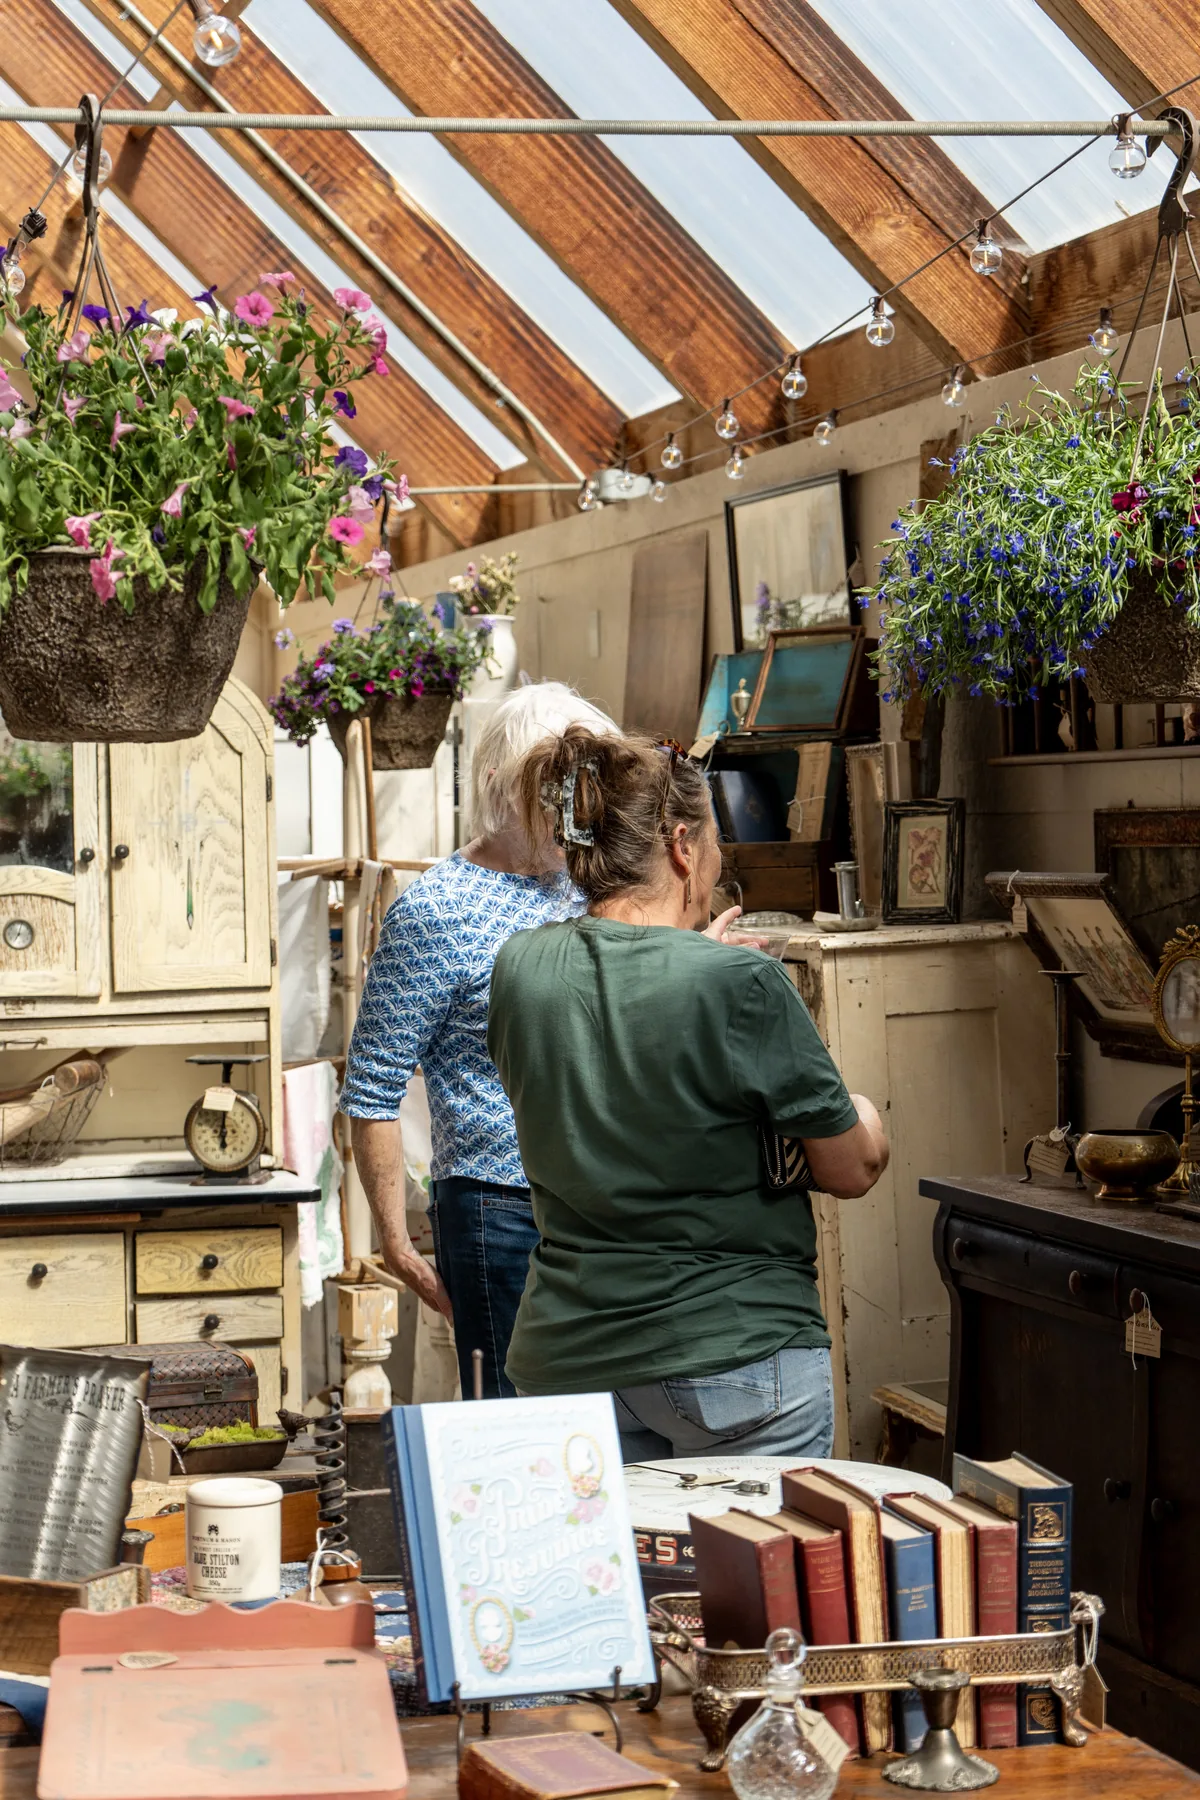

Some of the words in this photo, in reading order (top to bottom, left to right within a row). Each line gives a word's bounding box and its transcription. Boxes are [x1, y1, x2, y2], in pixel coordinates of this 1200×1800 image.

[10, 1374, 20, 1398] A
[23, 1375, 80, 1400] FARMER'S
[83, 1380, 126, 1411] PRAYER
[210, 1554, 240, 1566] STILTON
[1029, 1560, 1064, 1568] THEODORE
[201, 1566, 227, 1578] CHEESE
[1028, 1567, 1065, 1575] ROOSEVELT
[1028, 1589, 1065, 1597] BIOGRAPHY
